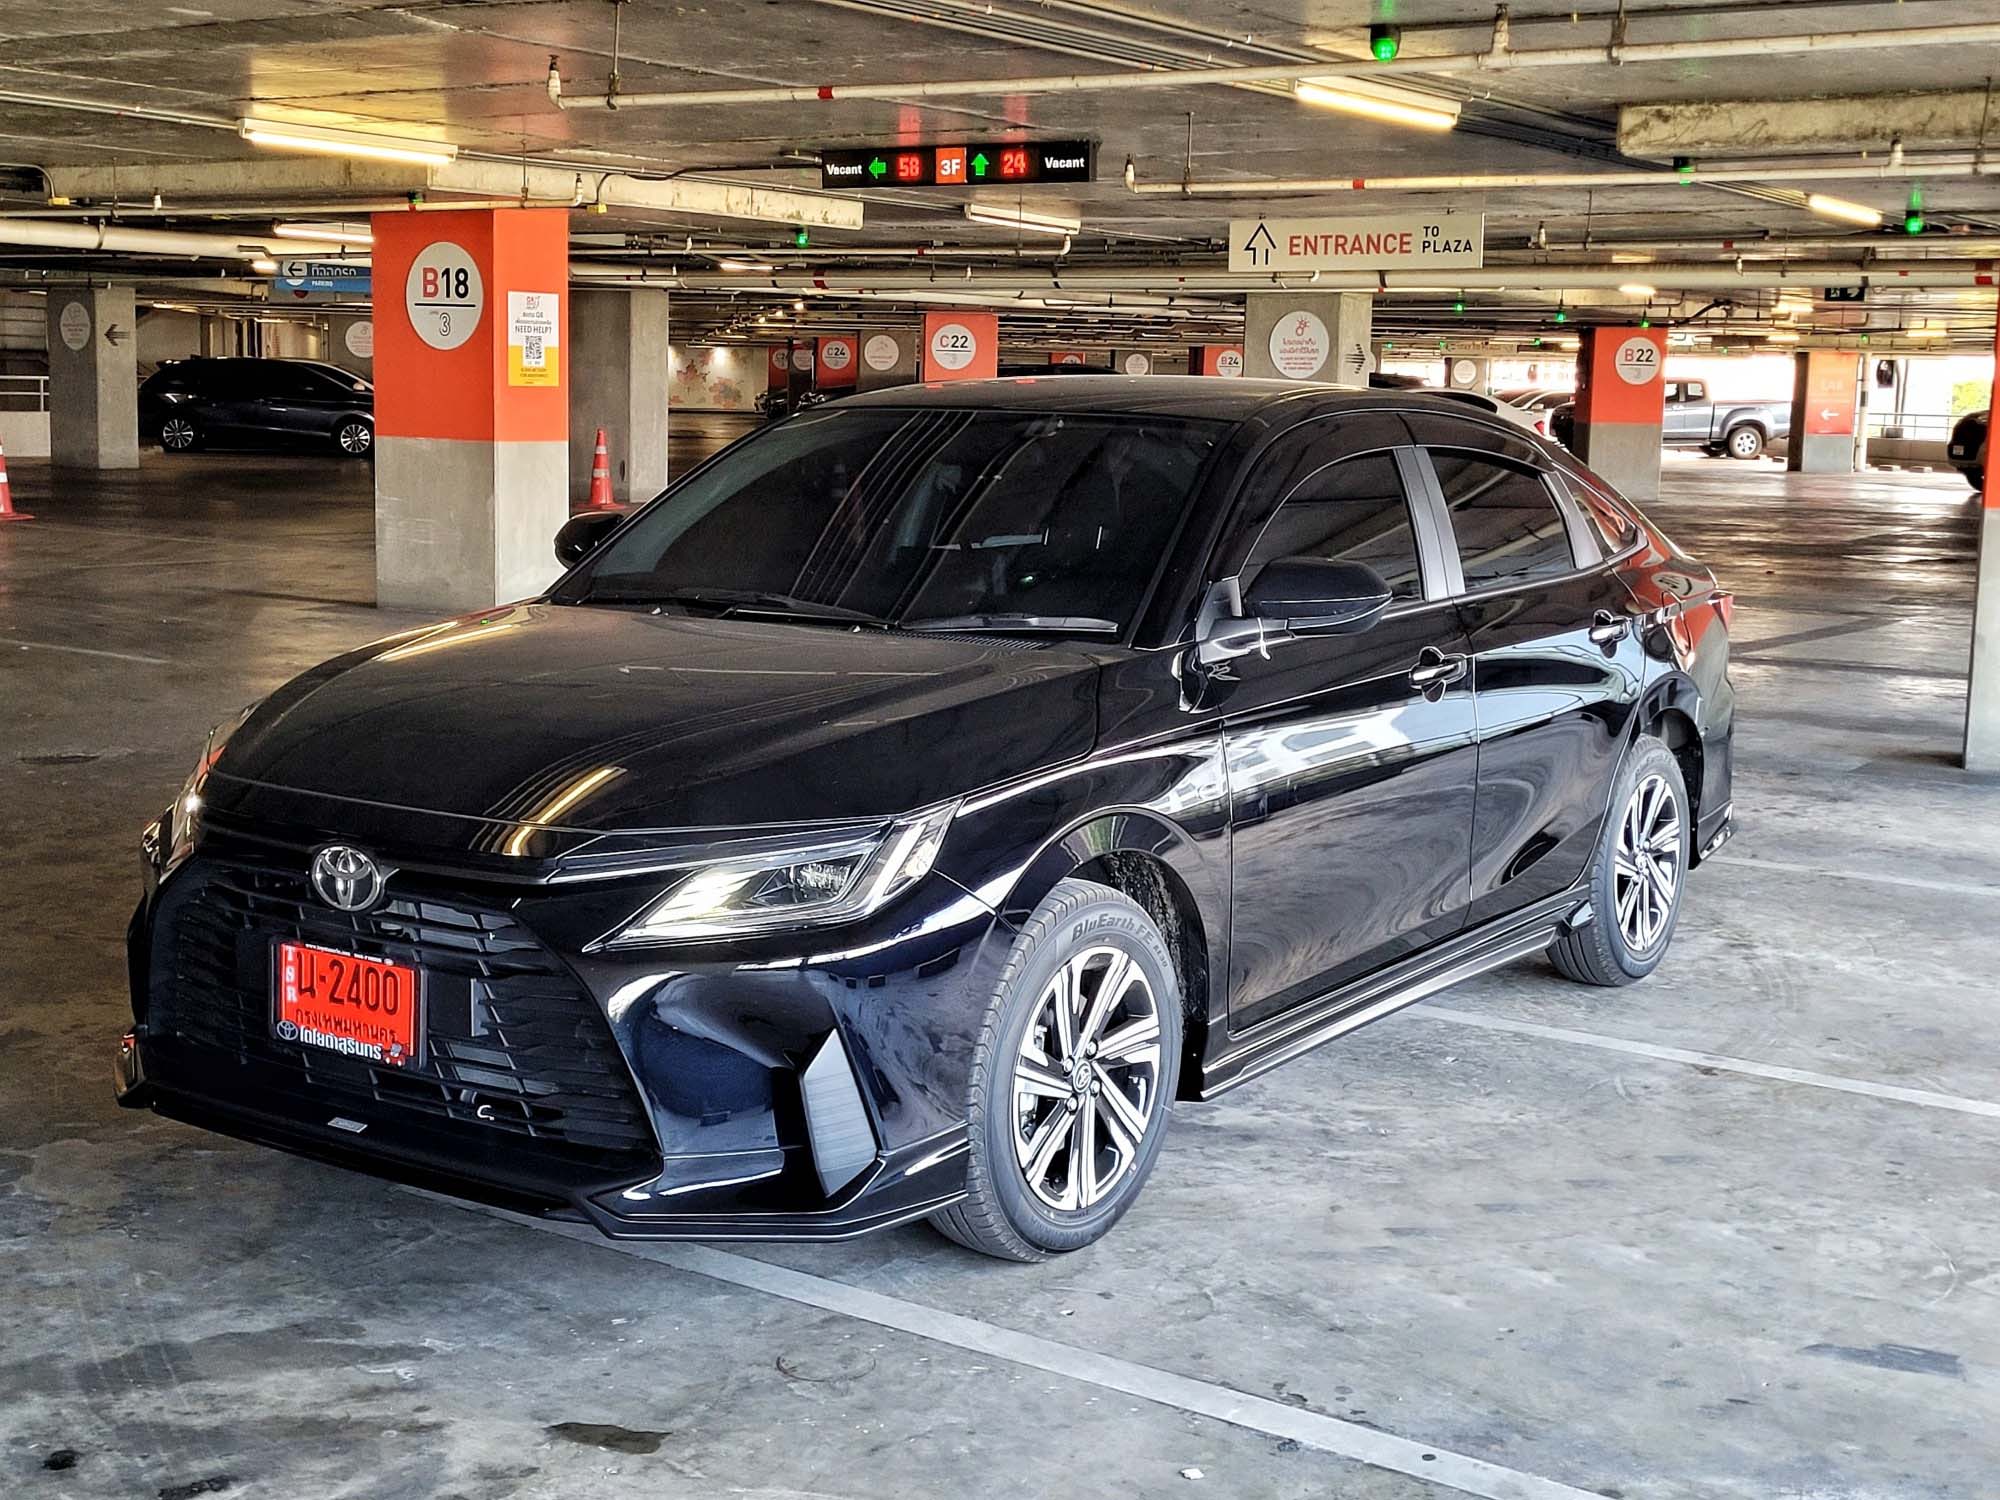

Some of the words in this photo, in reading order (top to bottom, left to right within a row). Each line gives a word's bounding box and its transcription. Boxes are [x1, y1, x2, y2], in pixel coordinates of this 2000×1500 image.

[826, 164, 862, 175] Vacant
[940, 159, 960, 175] 3F
[1003, 152, 1026, 174] 24
[1044, 156, 1085, 169] Vacant
[1423, 225, 1440, 237] TO
[1288, 232, 1413, 256] ENTRANCE
[1422, 239, 1473, 253] PLAZA
[422, 267, 469, 299] B18
[438, 312, 451, 336] 3
[515, 325, 532, 334] NEED
[939, 335, 969, 348] C22
[827, 347, 846, 356] C24
[1625, 348, 1654, 362] B22
[1221, 356, 1239, 365] B24
